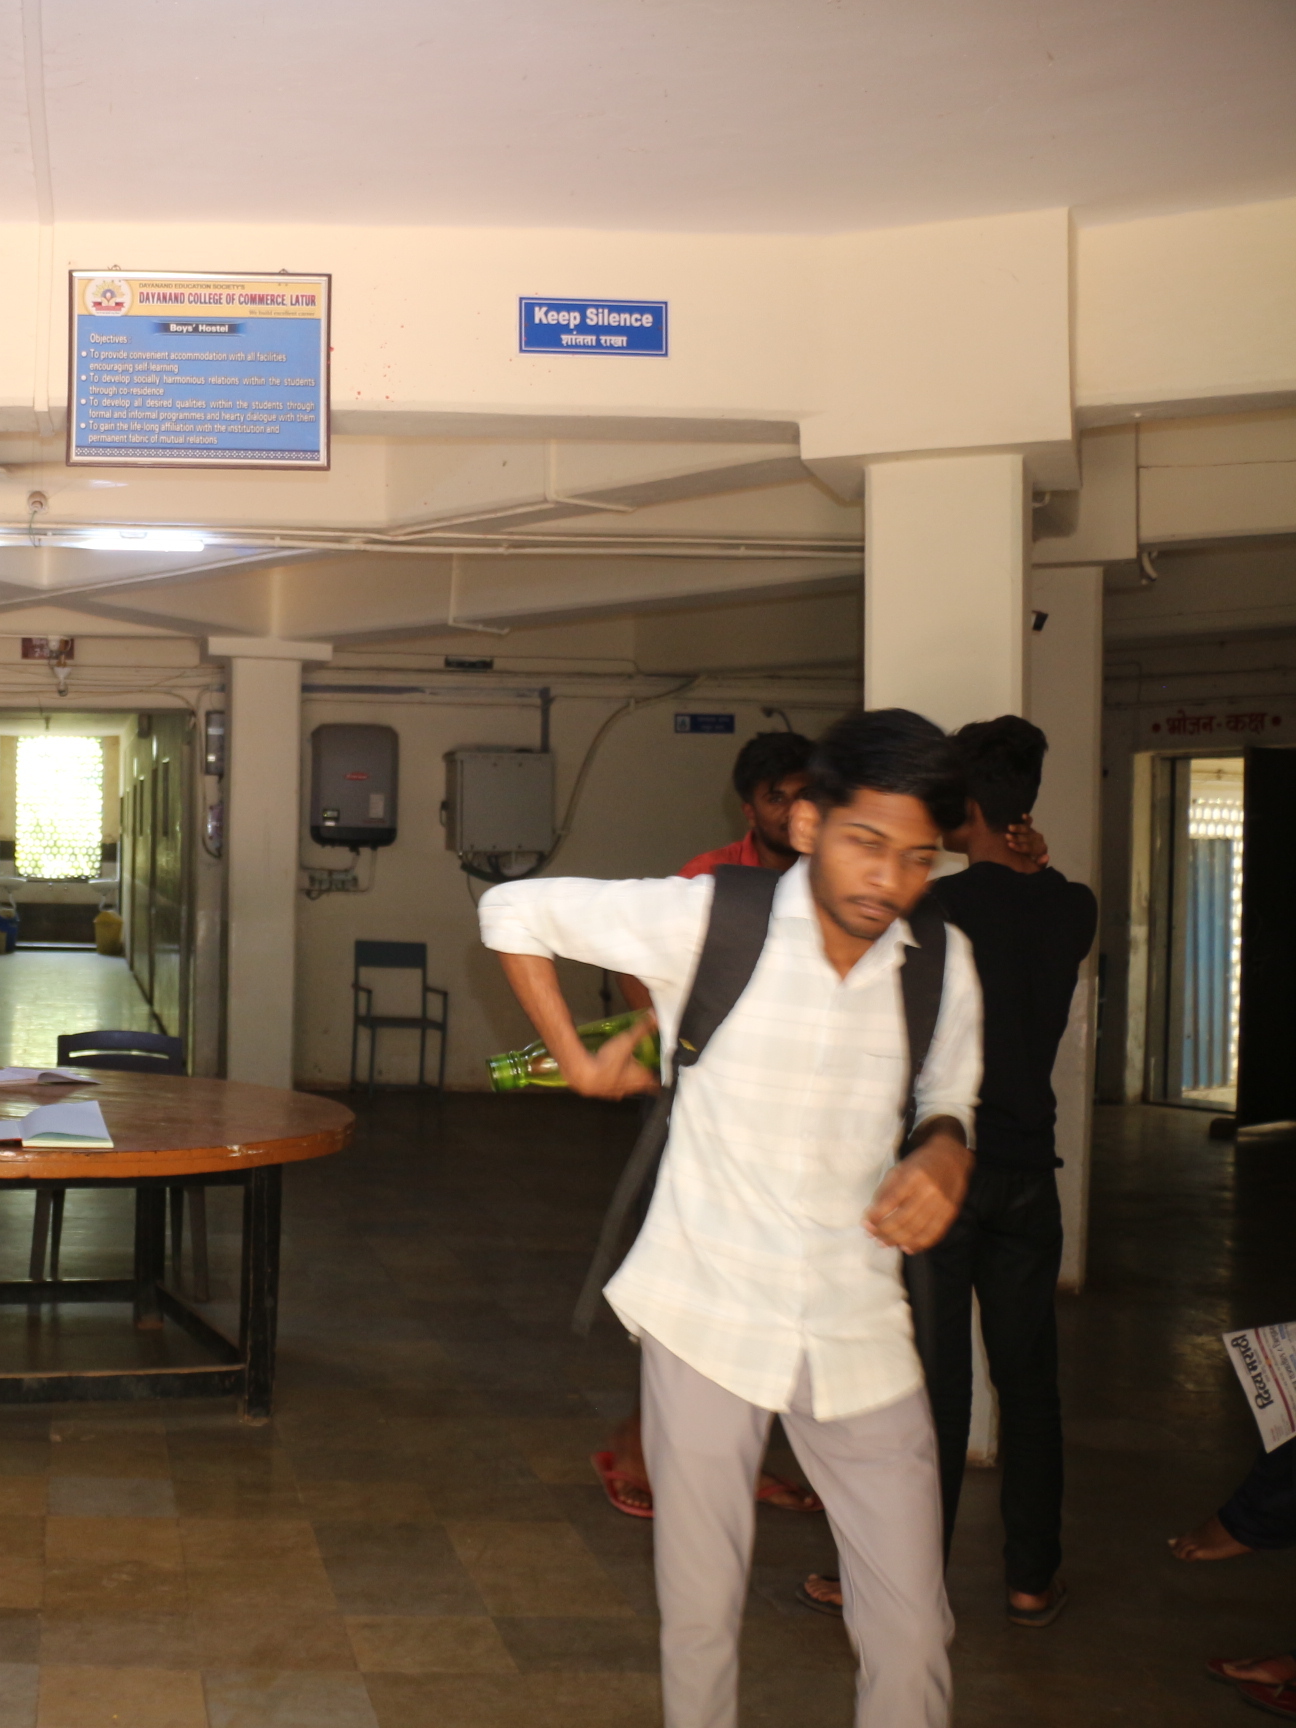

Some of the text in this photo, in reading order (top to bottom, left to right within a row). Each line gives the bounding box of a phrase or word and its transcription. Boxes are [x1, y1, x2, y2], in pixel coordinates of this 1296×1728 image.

[138, 291, 185, 304] DAYANAND
[188, 292, 224, 305] COLLEGE
[226, 293, 236, 305] OF
[290, 294, 316, 307] LATUR
[534, 306, 653, 329] Keep Silence
[170, 324, 228, 334] Boys' Hostel
[90, 333, 128, 345] Objectives
[560, 331, 628, 347] शांतता राखा
[90, 348, 286, 362] To provide convenient accommodation with all facilities
[90, 362, 179, 374] encouraging self-learning
[90, 372, 316, 387] To develop socially harmonious relations within the students
[89, 385, 164, 396] through co-residence
[89, 396, 315, 412] To develop all desired qualities within the students through
[89, 409, 316, 424] formal and informal programmes and hearty dialogue with them
[89, 420, 280, 434] To gain the life-long affiliation with the institution and
[88, 433, 218, 445] permanent fabric of mutual relations
